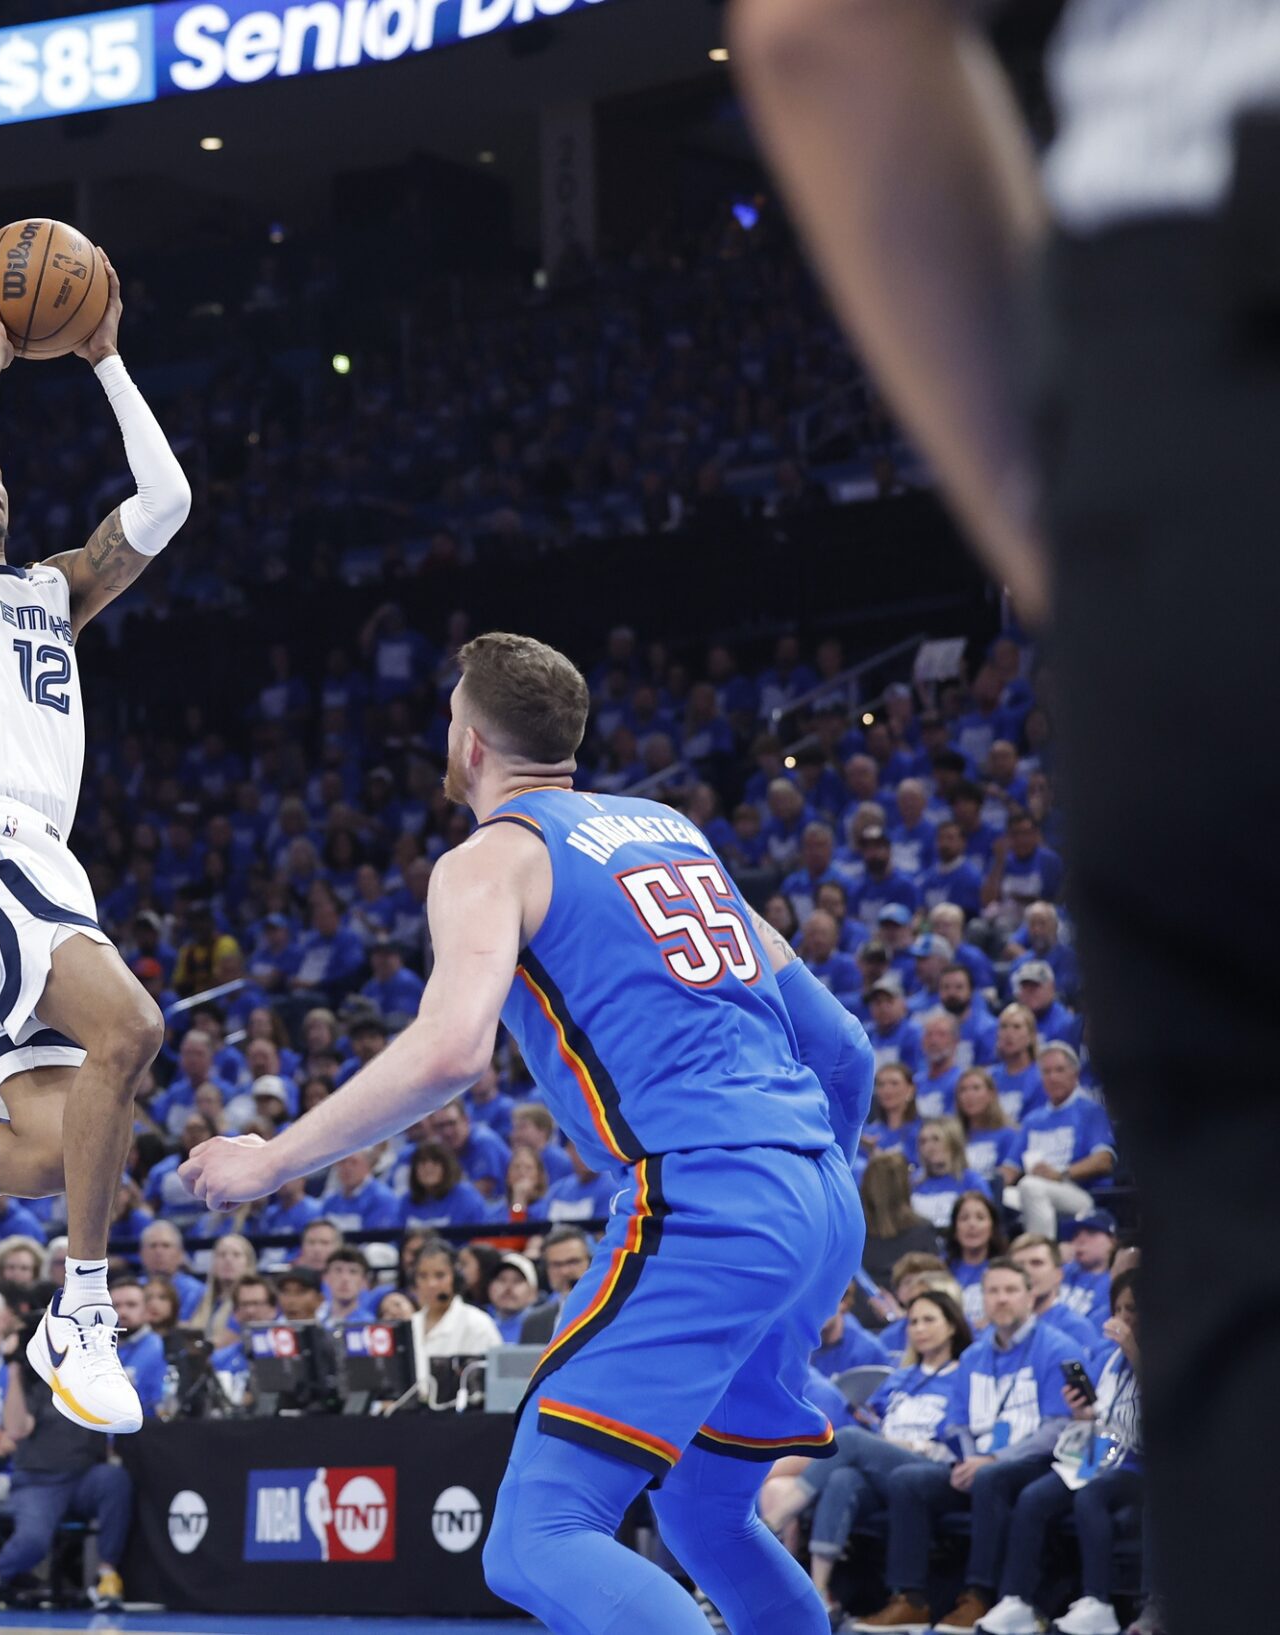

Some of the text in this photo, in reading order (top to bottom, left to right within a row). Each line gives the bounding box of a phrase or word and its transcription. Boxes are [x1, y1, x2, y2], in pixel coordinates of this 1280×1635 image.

[169, 0, 445, 91] Senior
[2, 221, 43, 301] Wilson
[13, 638, 72, 715] 12
[613, 860, 761, 988] 55
[255, 1486, 302, 1543] NBA
